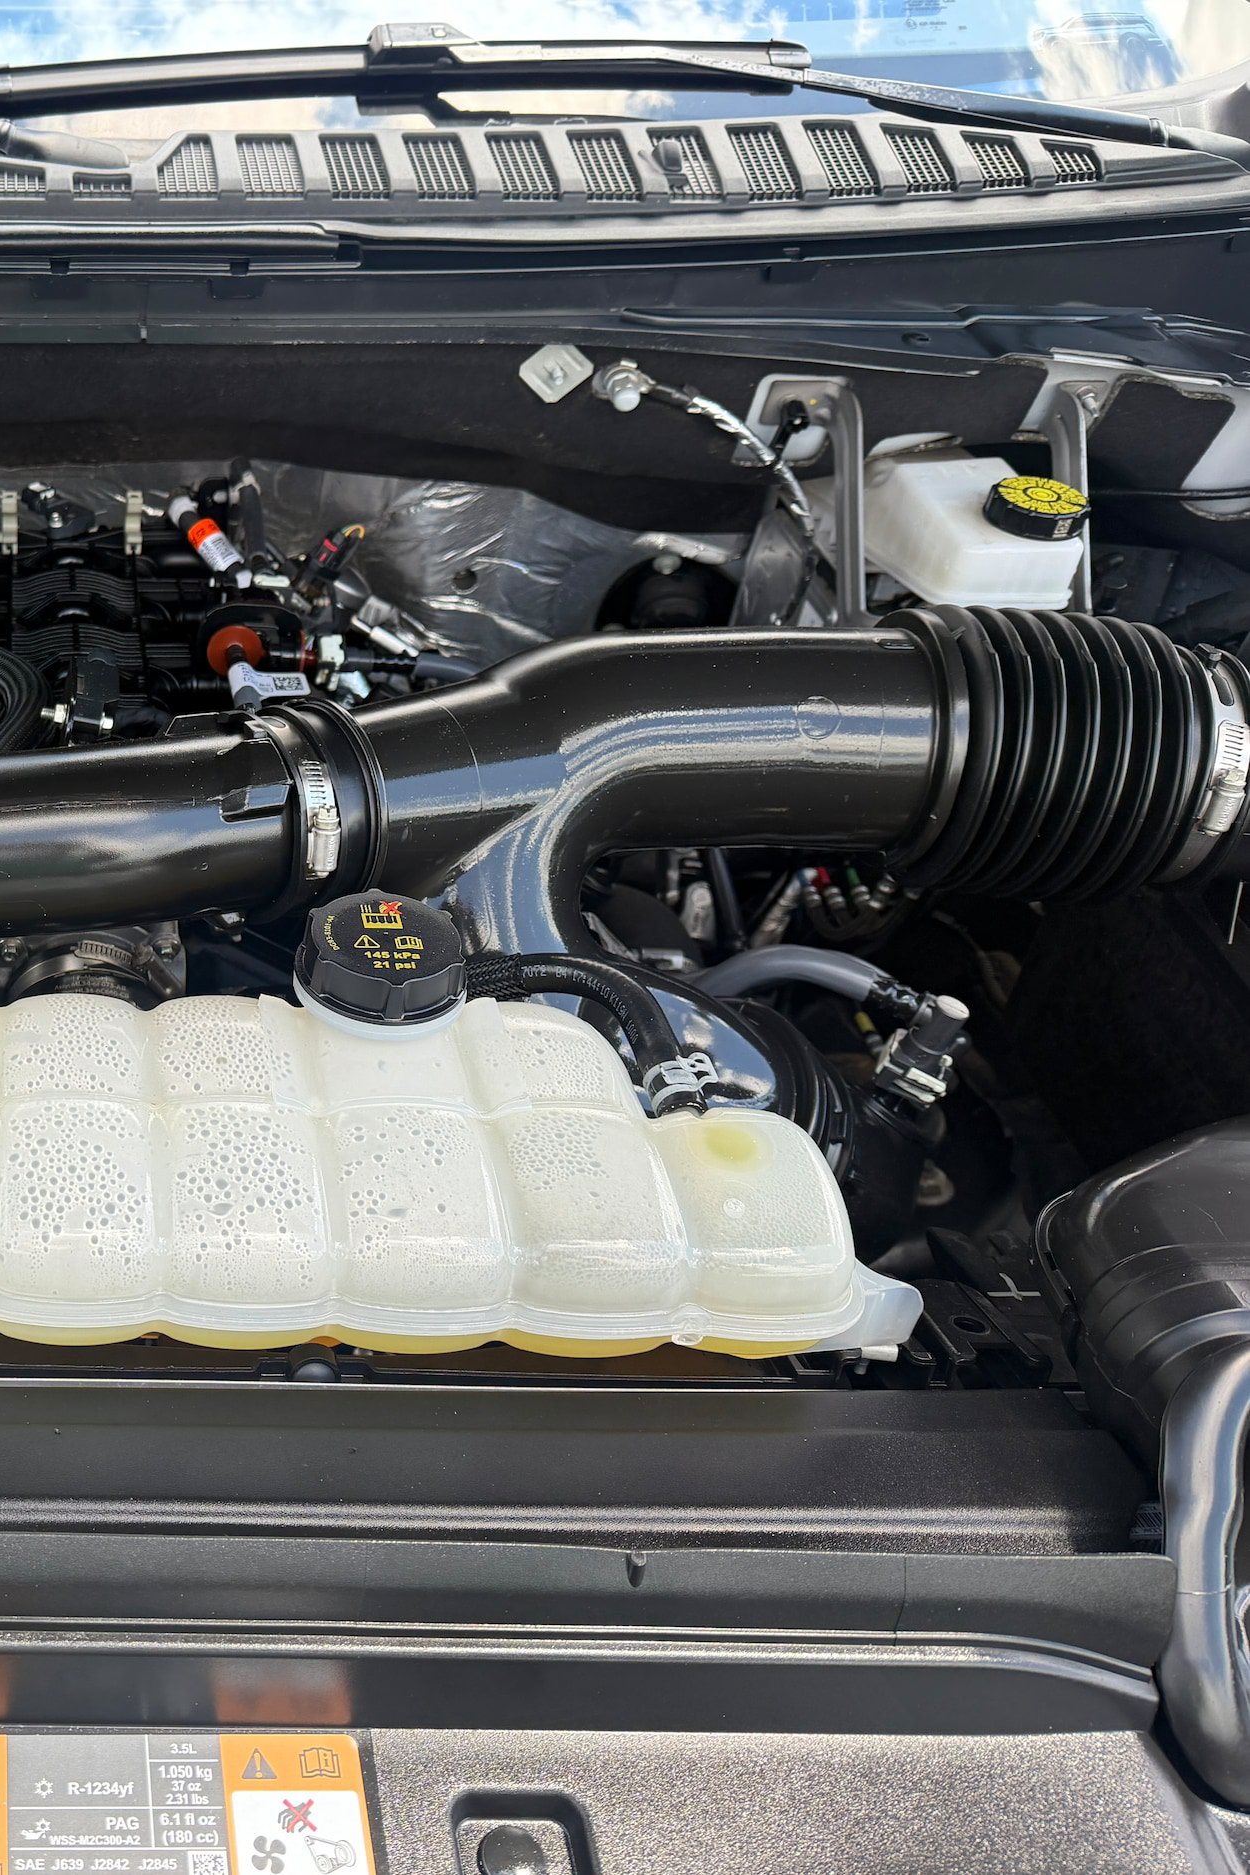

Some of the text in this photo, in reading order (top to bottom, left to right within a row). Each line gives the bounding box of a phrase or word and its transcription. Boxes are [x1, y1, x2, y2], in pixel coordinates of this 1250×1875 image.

[364, 950, 422, 960] 145 kPa
[372, 960, 417, 971] 21 psi
[169, 1743, 198, 1755] 3.5L
[158, 1765, 213, 1781] 1.050 kg
[67, 1781, 135, 1797] R-1234yf
[171, 1780, 202, 1792] 37 oz
[165, 1793, 210, 1805] 2.31 lbs
[105, 1816, 140, 1831] PAG
[159, 1813, 217, 1826] 6.1 fl oz
[162, 1830, 219, 1846] (180 cc)
[15, 1858, 178, 1872] SAE J639 J2842 J2845
